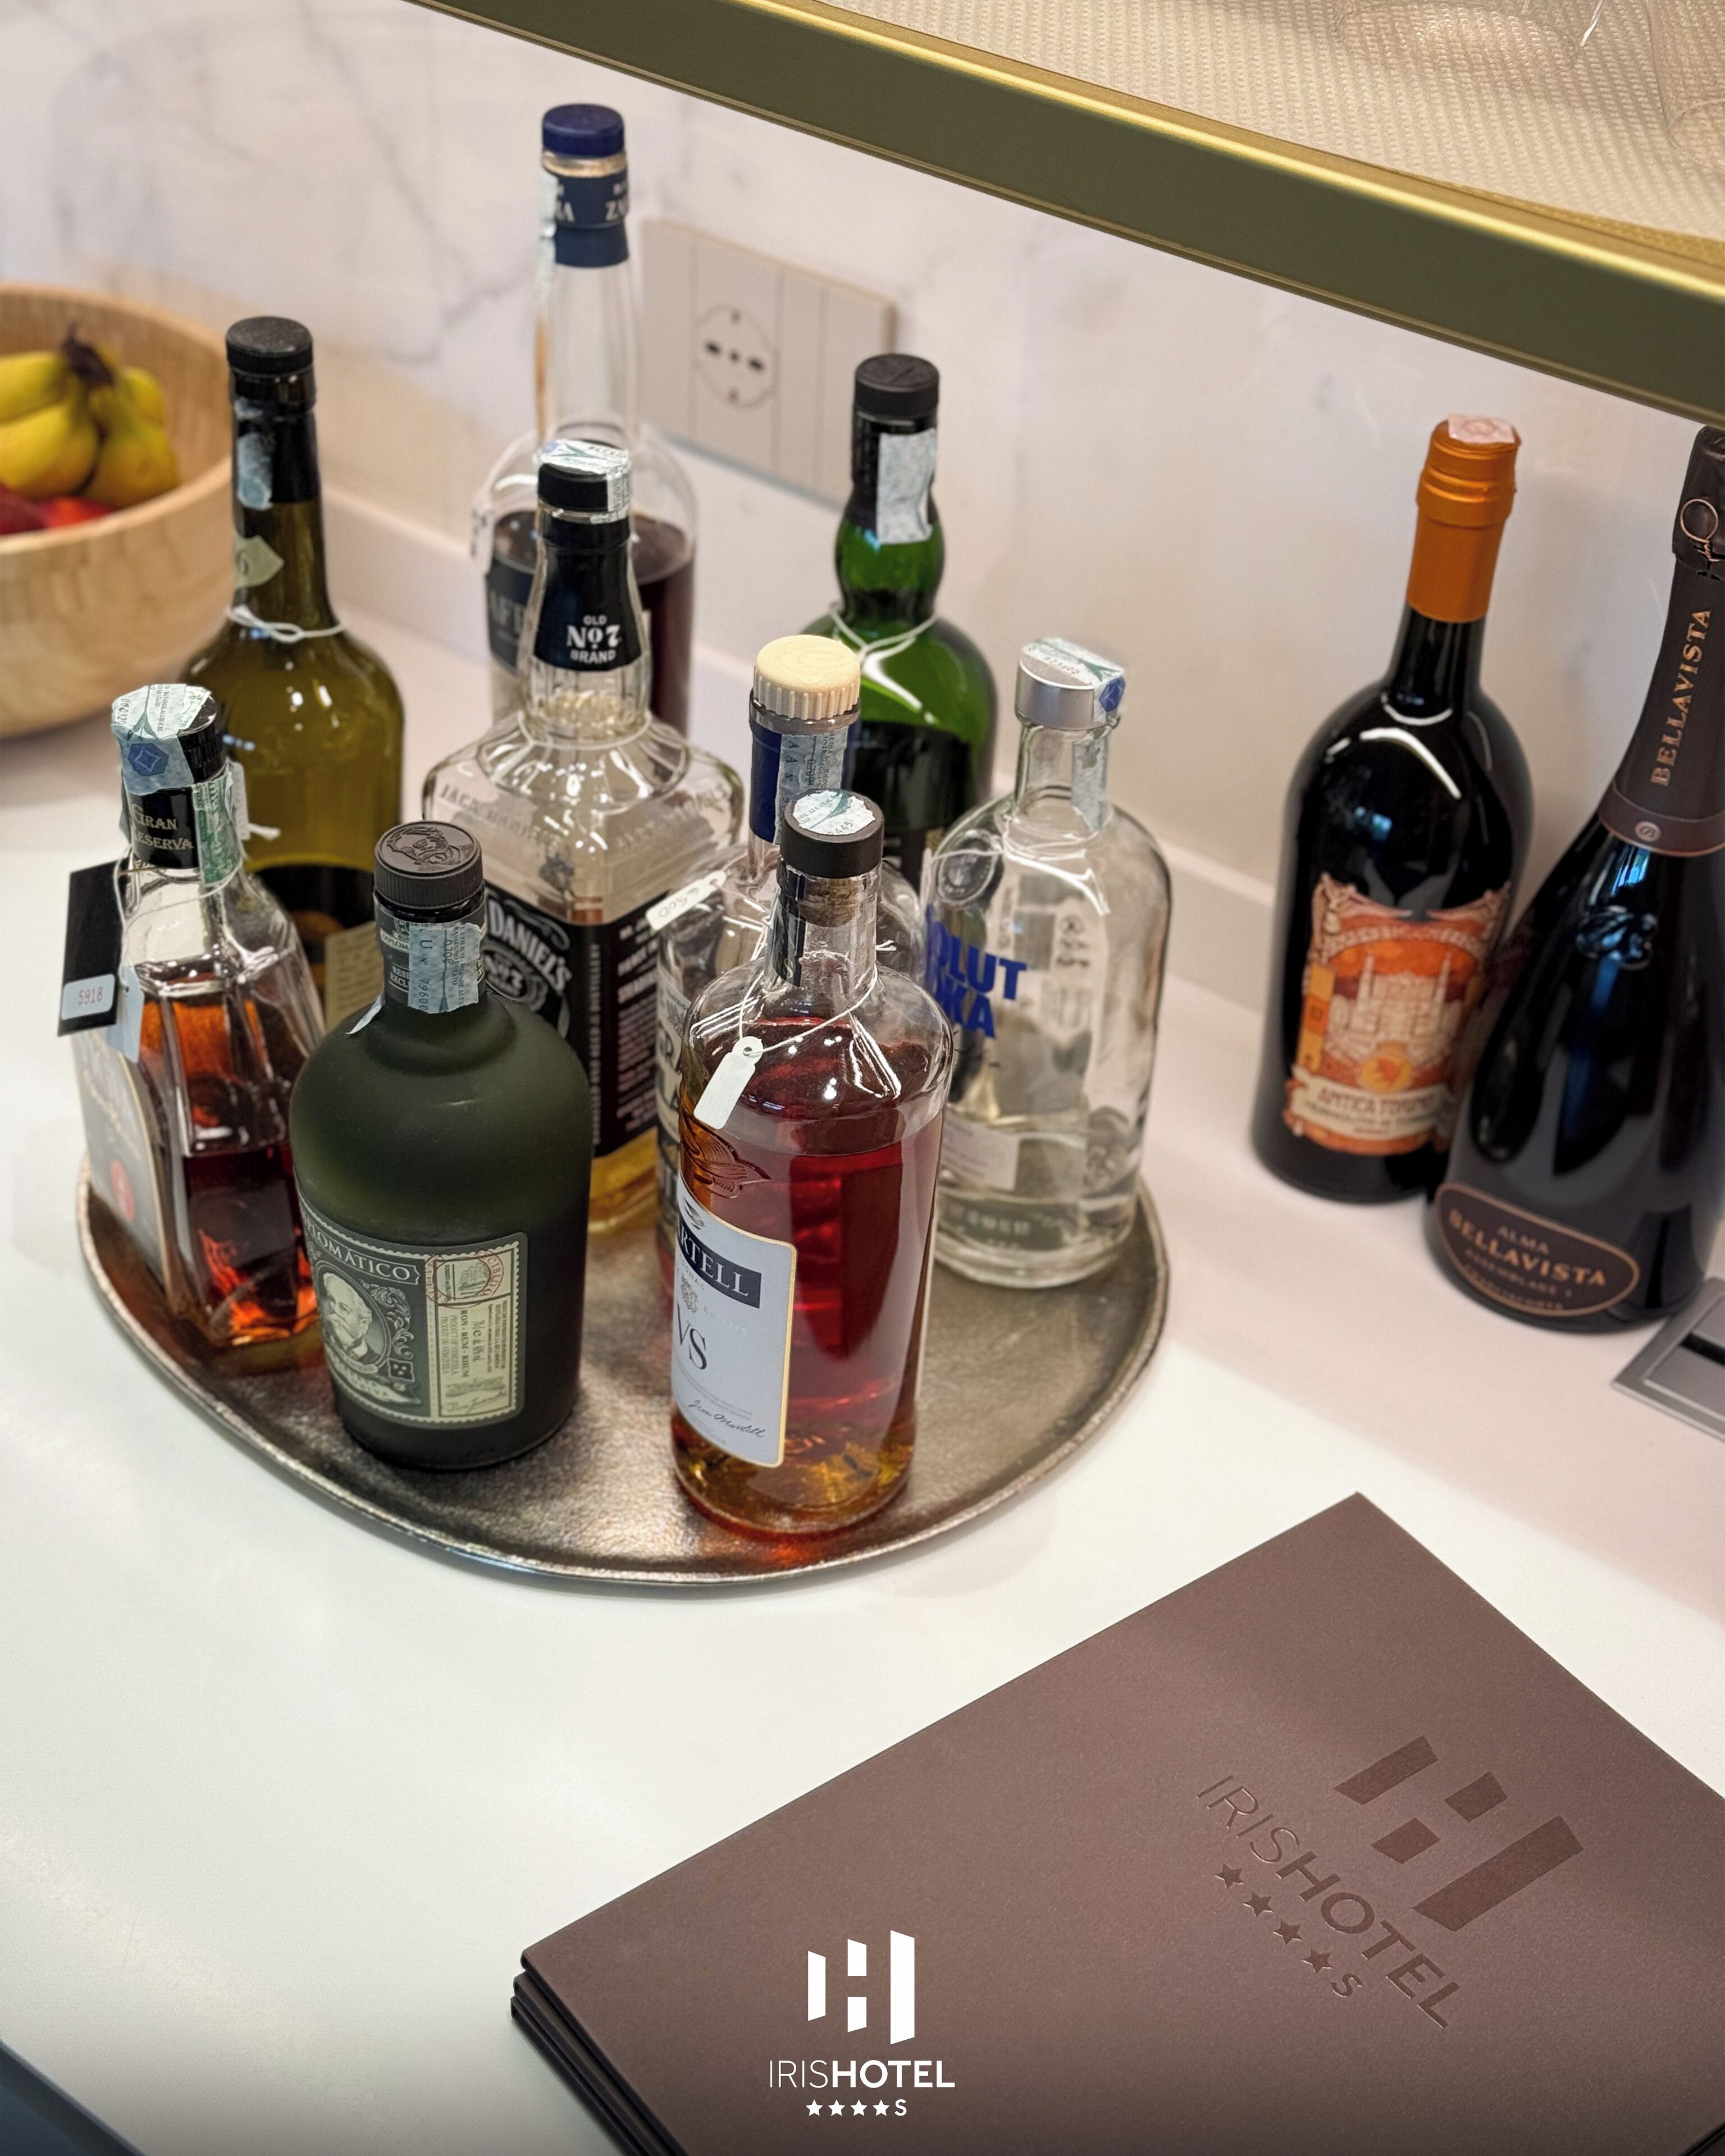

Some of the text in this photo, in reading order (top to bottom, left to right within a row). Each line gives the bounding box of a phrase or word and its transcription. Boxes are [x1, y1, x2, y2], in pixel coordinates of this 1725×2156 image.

[583, 615, 607, 626] OLD
[570, 649, 617, 664] BRAND
[1650, 609, 1712, 786] BELLAVISTA
[131, 803, 177, 830] GRAN
[390, 973, 409, 988] EXCL
[393, 965, 409, 980] RESE
[78, 986, 104, 1006] 5918
[678, 1224, 749, 1297] RTELL
[1448, 1208, 1607, 1286] BELLAVISTA
[677, 1302, 708, 1371] VS
[1195, 1775, 1460, 2030] IRISHOTEL
